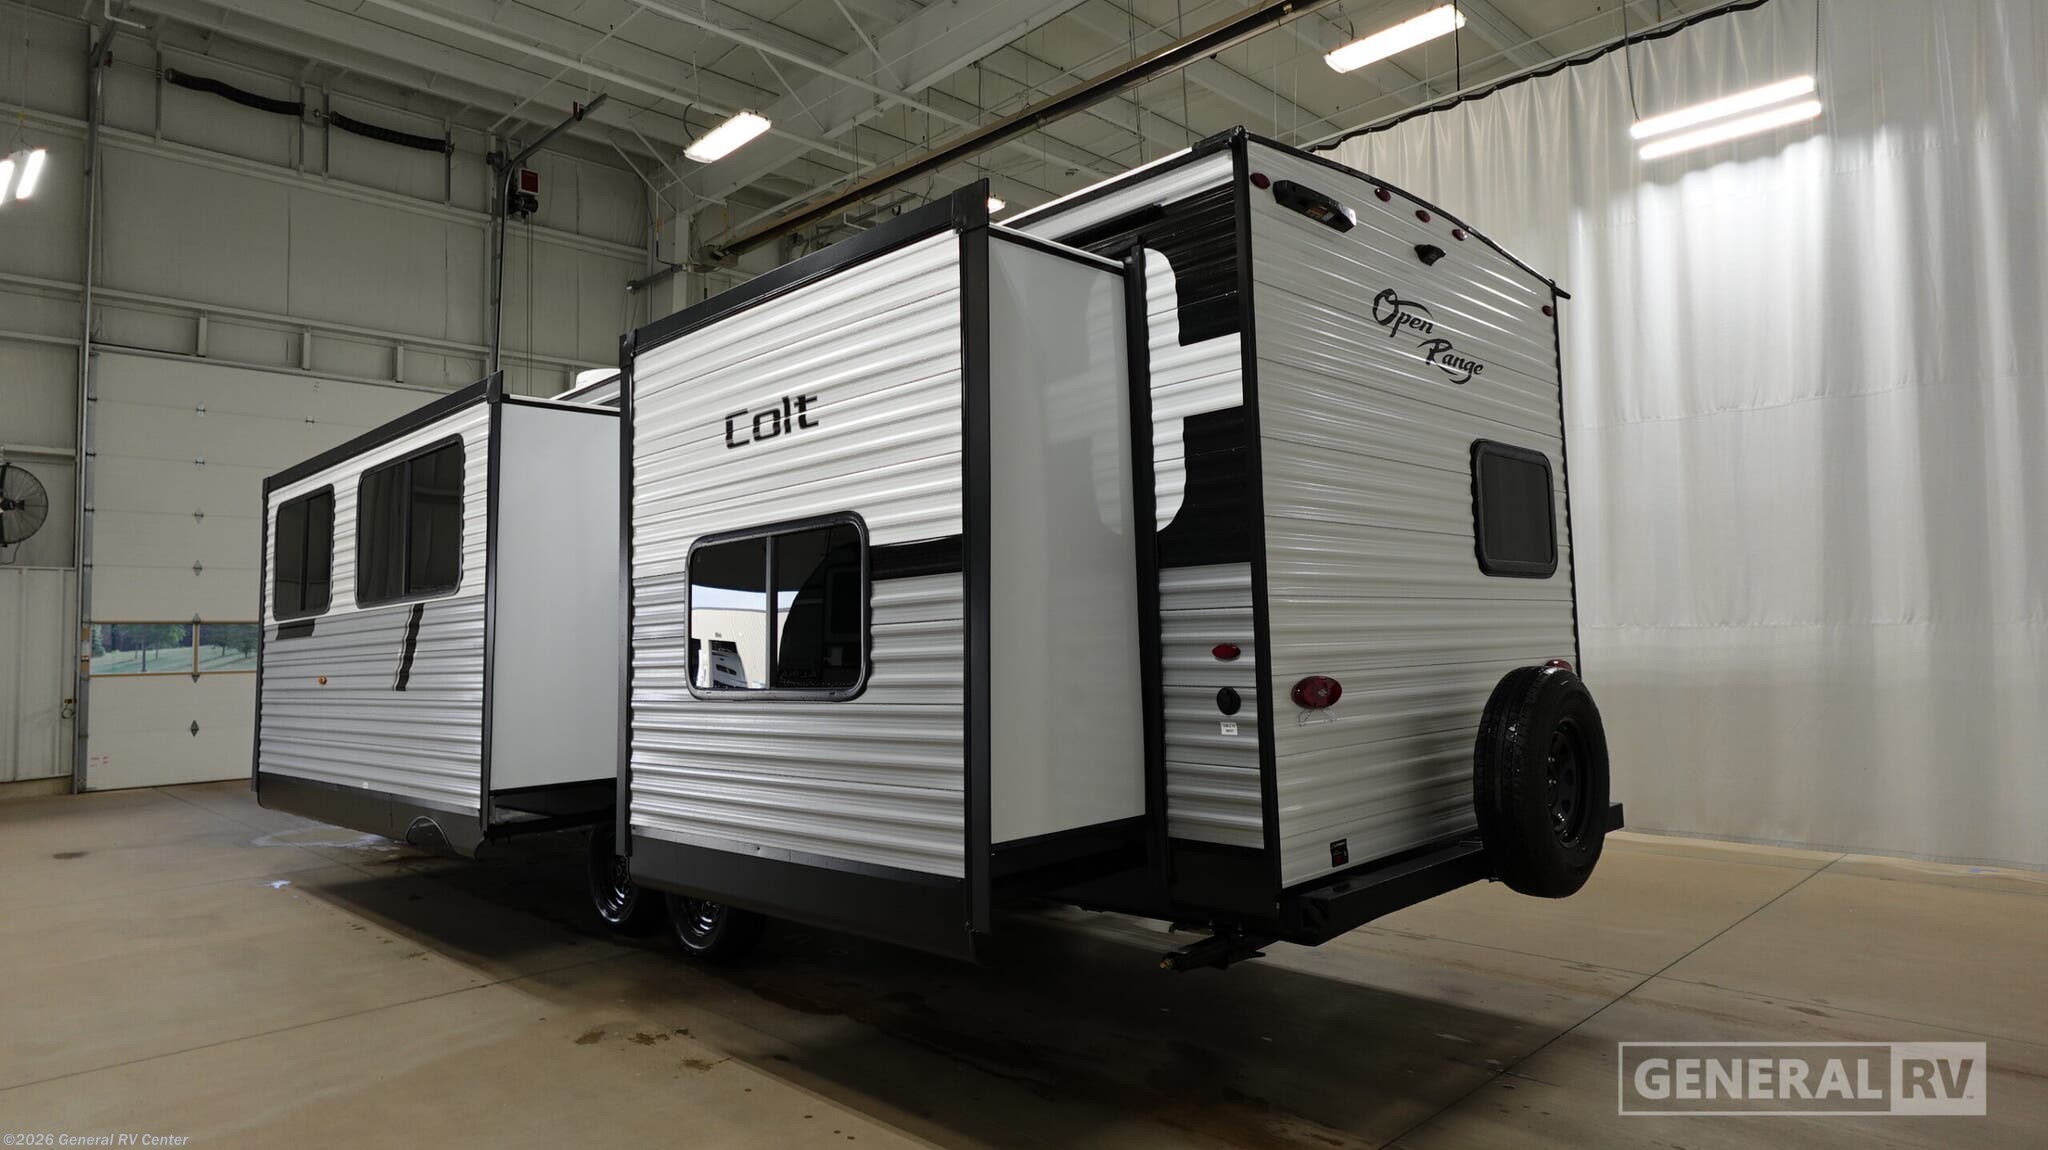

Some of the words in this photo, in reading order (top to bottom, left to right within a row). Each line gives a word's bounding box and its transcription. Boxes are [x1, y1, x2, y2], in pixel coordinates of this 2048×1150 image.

[1372, 288, 1434, 338] Open
[1417, 338, 1484, 385] Range
[725, 394, 819, 449] Colt
